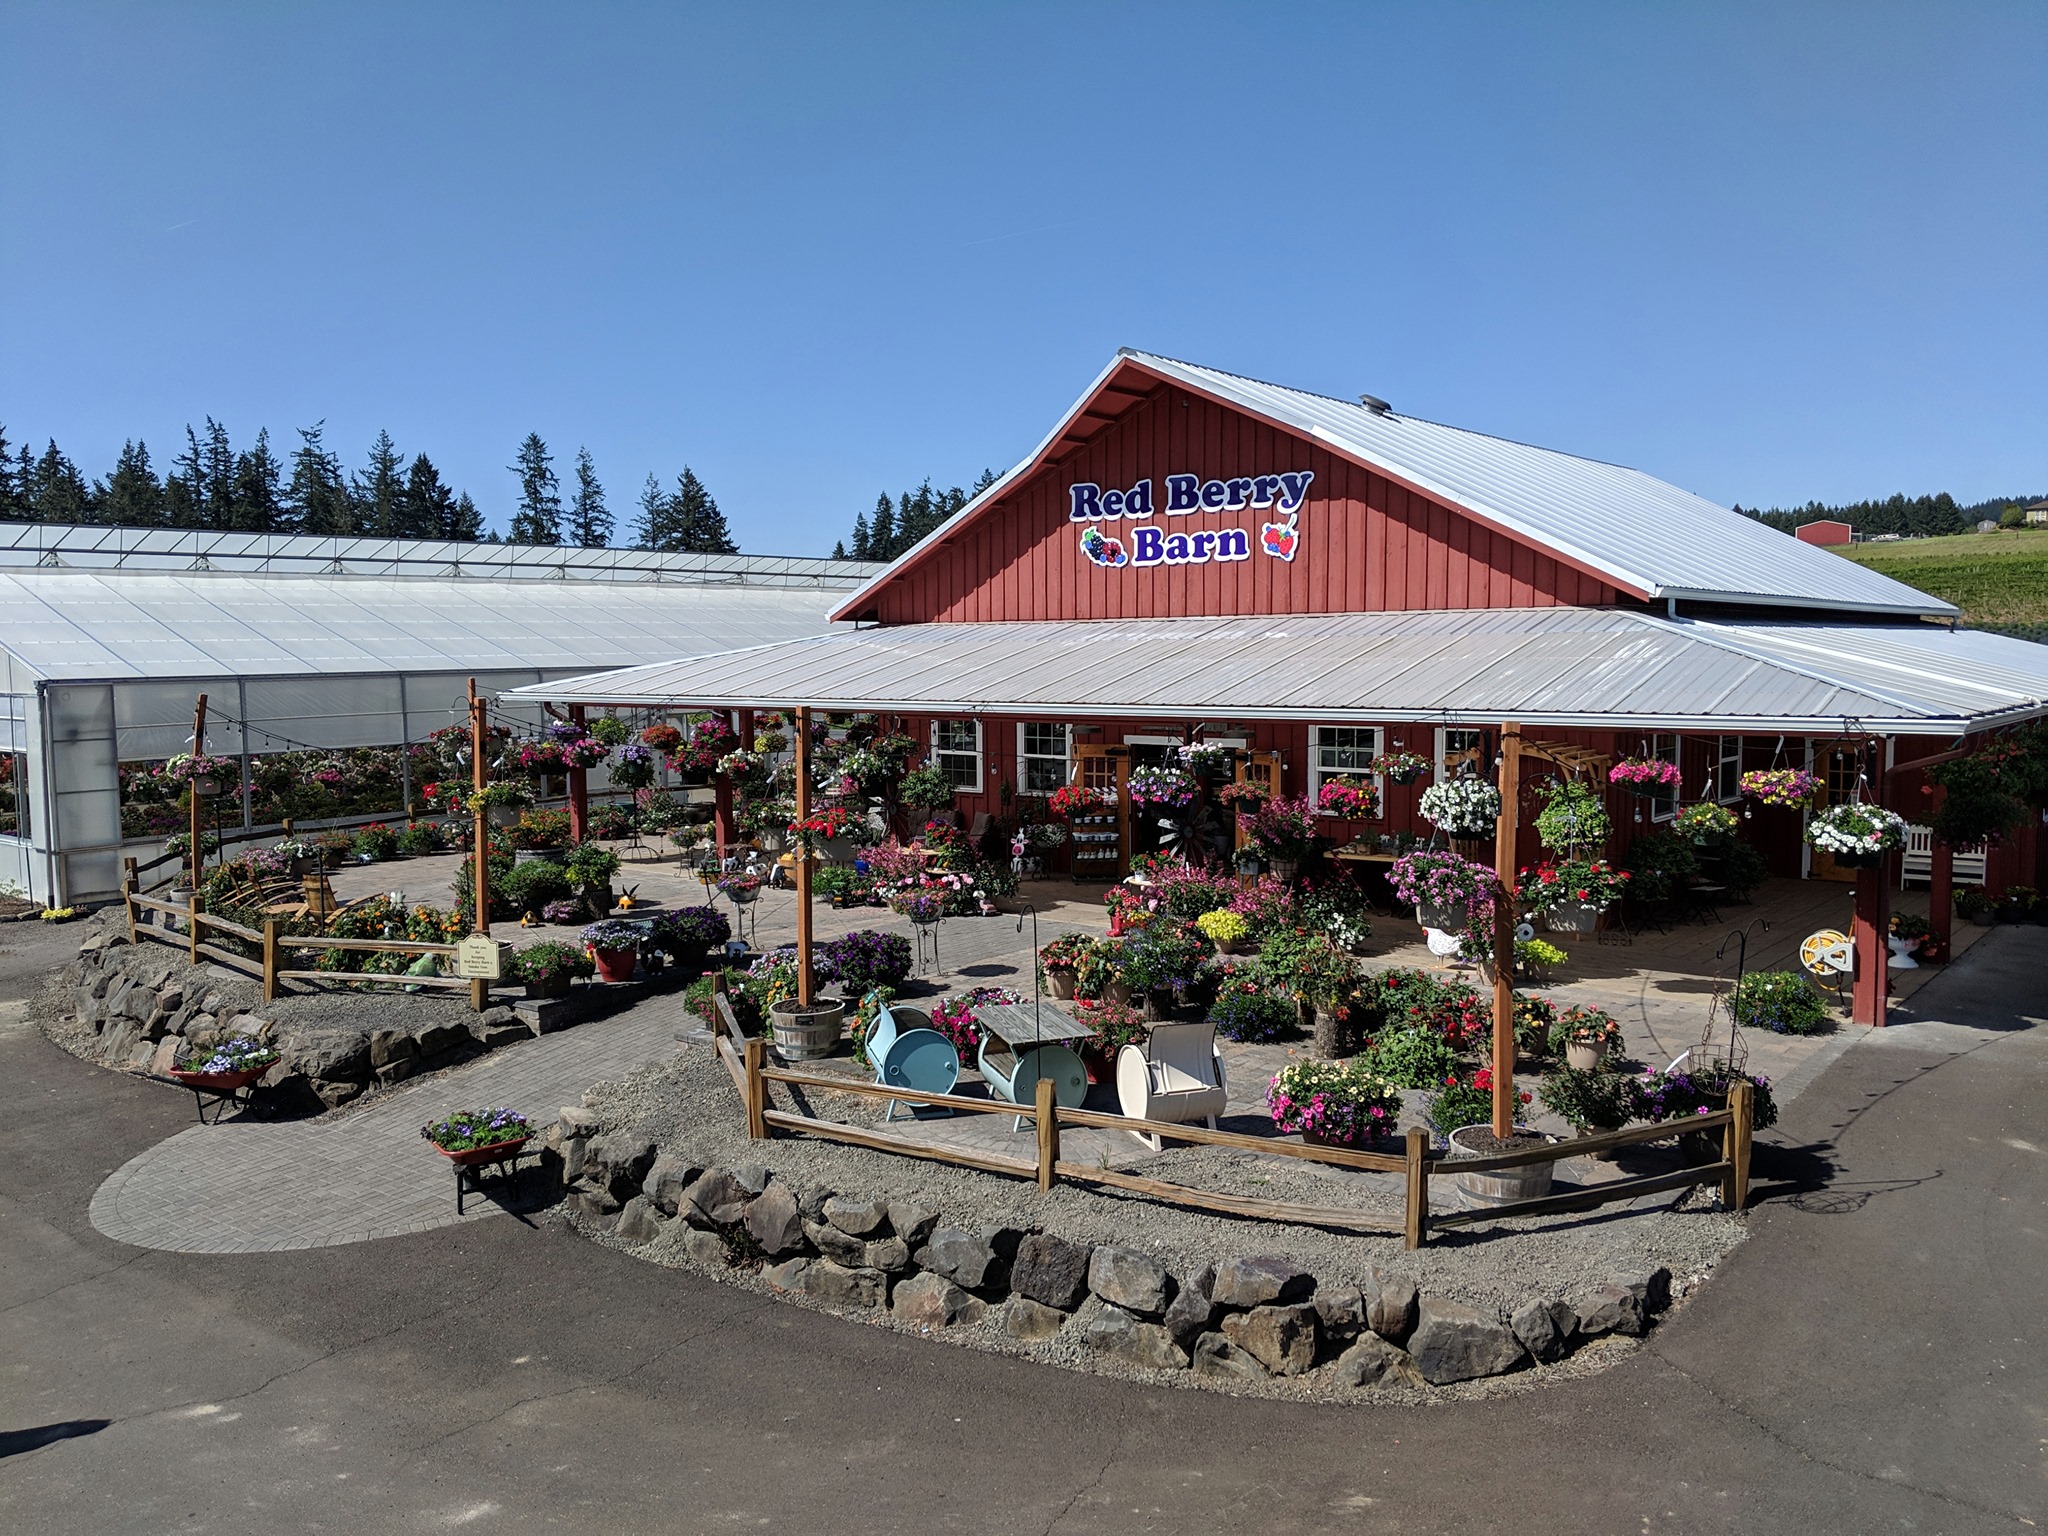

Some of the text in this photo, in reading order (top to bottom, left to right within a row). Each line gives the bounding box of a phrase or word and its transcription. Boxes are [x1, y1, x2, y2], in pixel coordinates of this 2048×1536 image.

[1070, 472, 1313, 521] Red Berry
[1132, 527, 1249, 566] Barn
